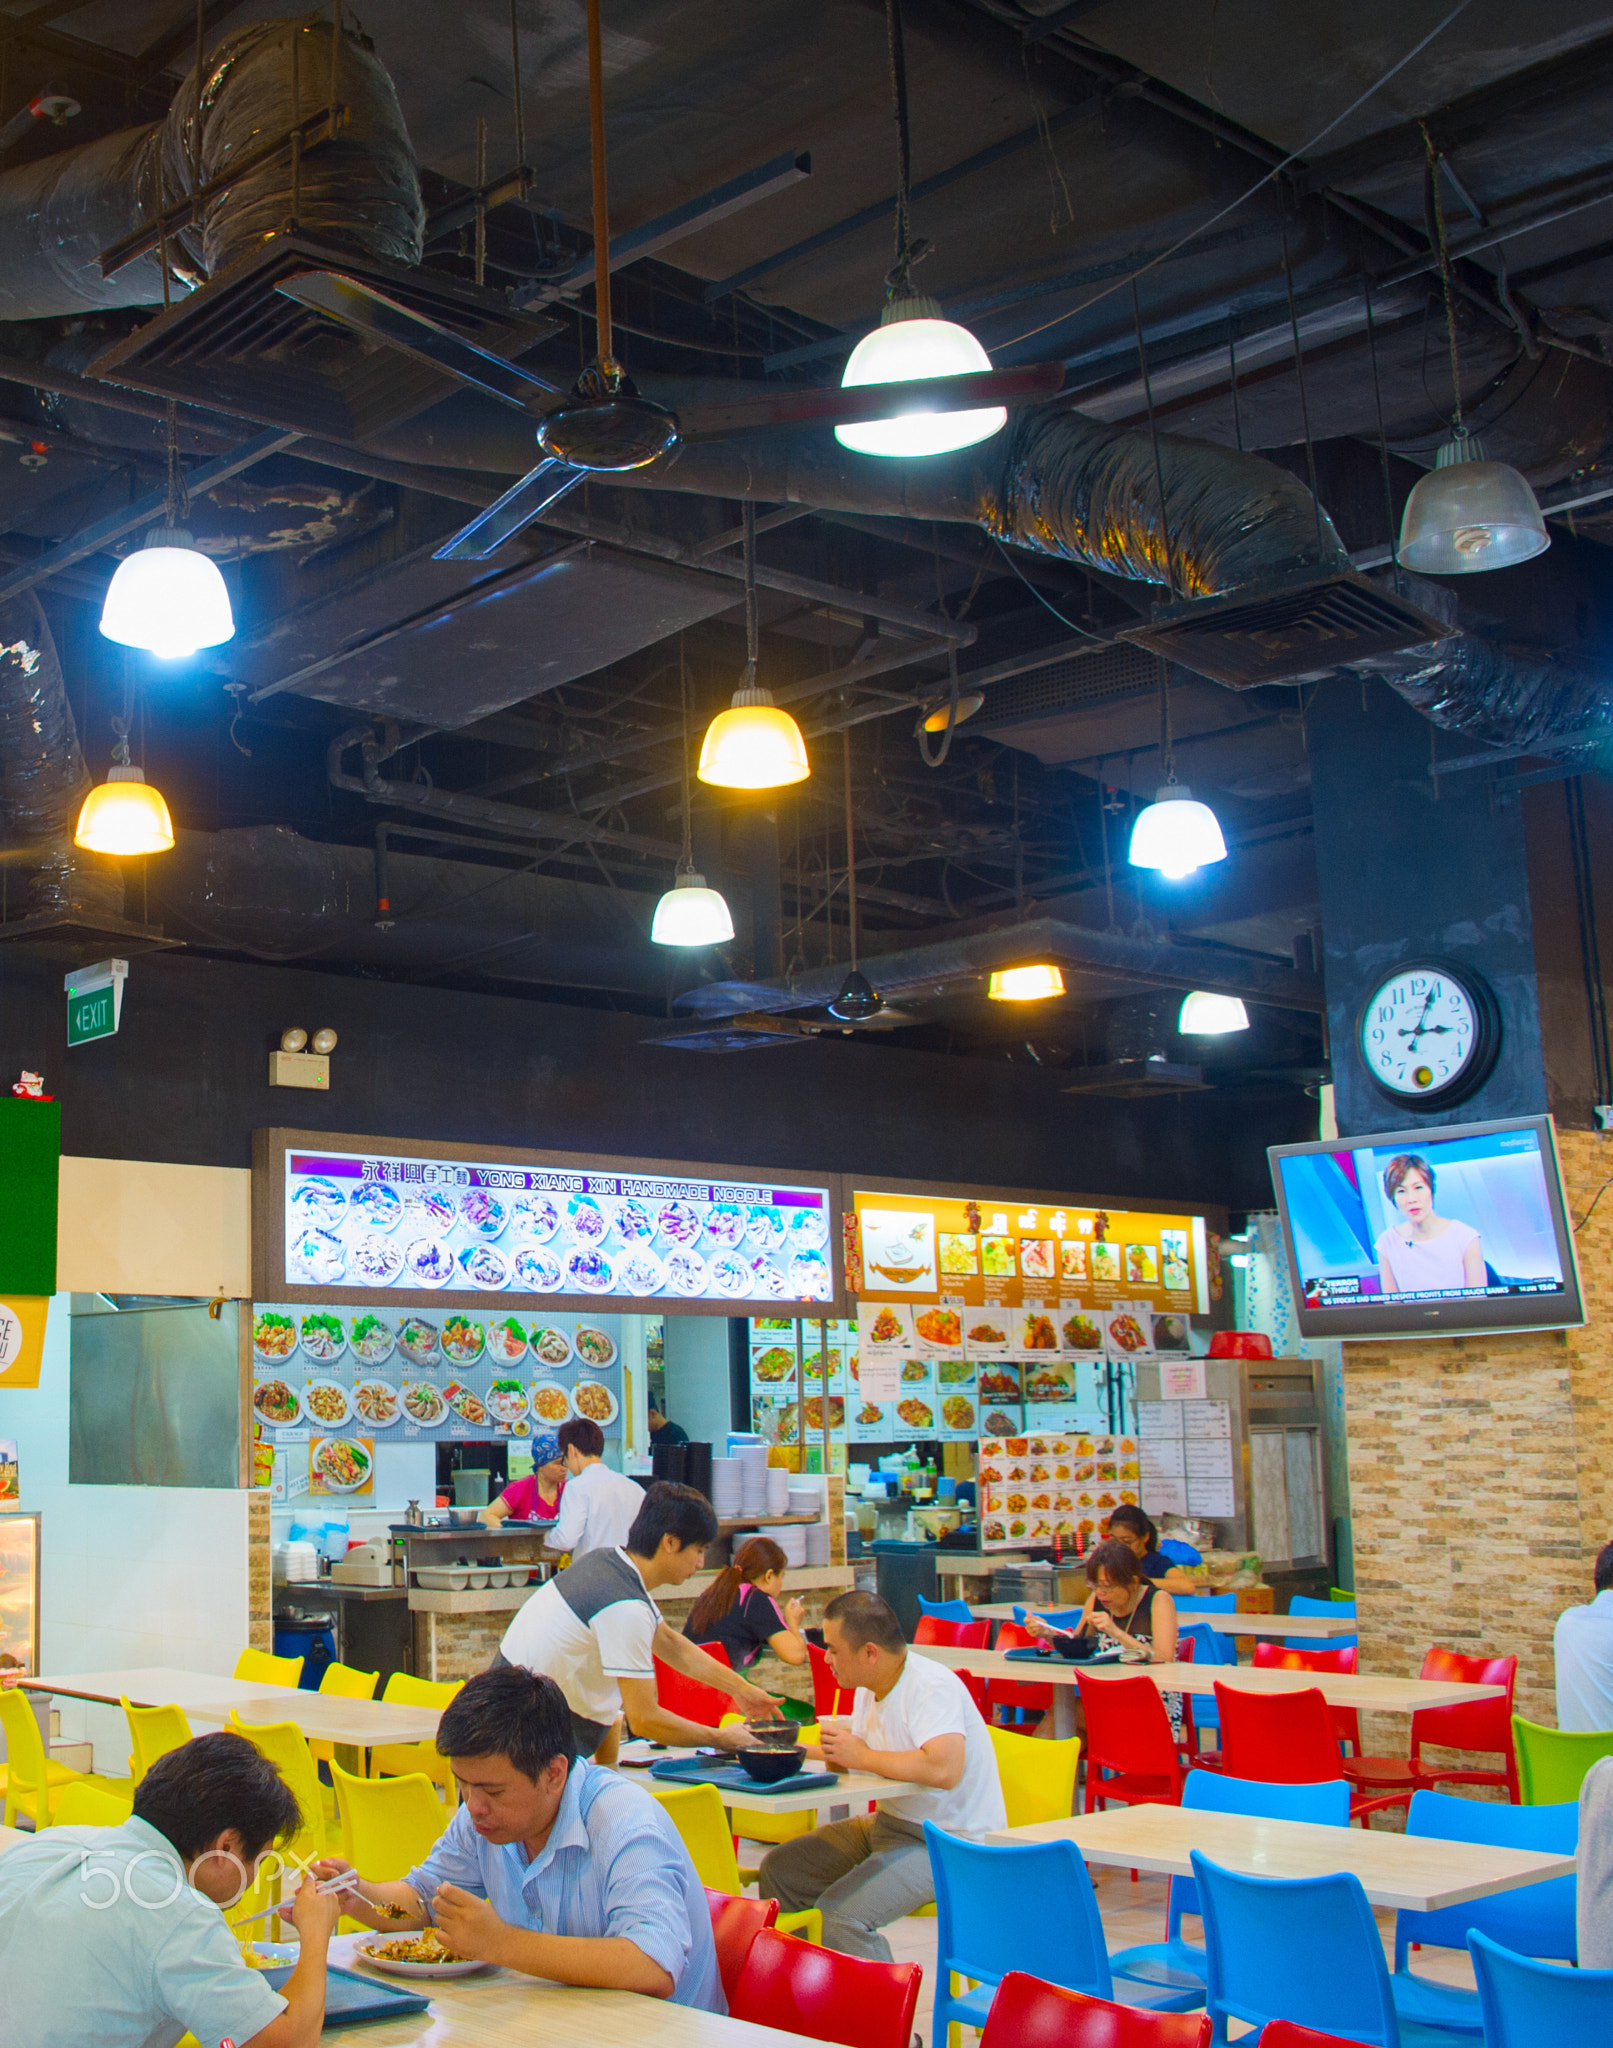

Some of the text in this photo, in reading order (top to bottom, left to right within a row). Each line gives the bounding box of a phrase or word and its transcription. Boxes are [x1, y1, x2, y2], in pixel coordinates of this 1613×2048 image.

[1411, 978, 1427, 996] 12
[1392, 988, 1405, 1005] 11
[1448, 994, 1461, 1013] 2
[82, 998, 108, 1032] EXIT
[1378, 1005, 1394, 1023] 10
[1457, 1016, 1470, 1036] 3
[1372, 1028, 1385, 1046] 9
[1381, 1049, 1393, 1068] 8
[1450, 1041, 1462, 1058] 4
[1396, 1062, 1407, 1080] 7
[1437, 1059, 1450, 1078] 5
[476, 1169, 774, 1205] YONG XIANG XIN HANDMADE NOODLE
[1326, 1278, 1359, 1287] TERROR
[1331, 1286, 1359, 1294] THREAT
[1333, 1295, 1356, 1304] STOCKS
[1370, 1292, 1391, 1302] MIXED
[1391, 1291, 1416, 1301] DESPITE
[1416, 1290, 1442, 1300] PROFITS
[1442, 1288, 1462, 1297] FROM
[1462, 1287, 1486, 1296] MAJOR
[1486, 1285, 1510, 1295] BANKS
